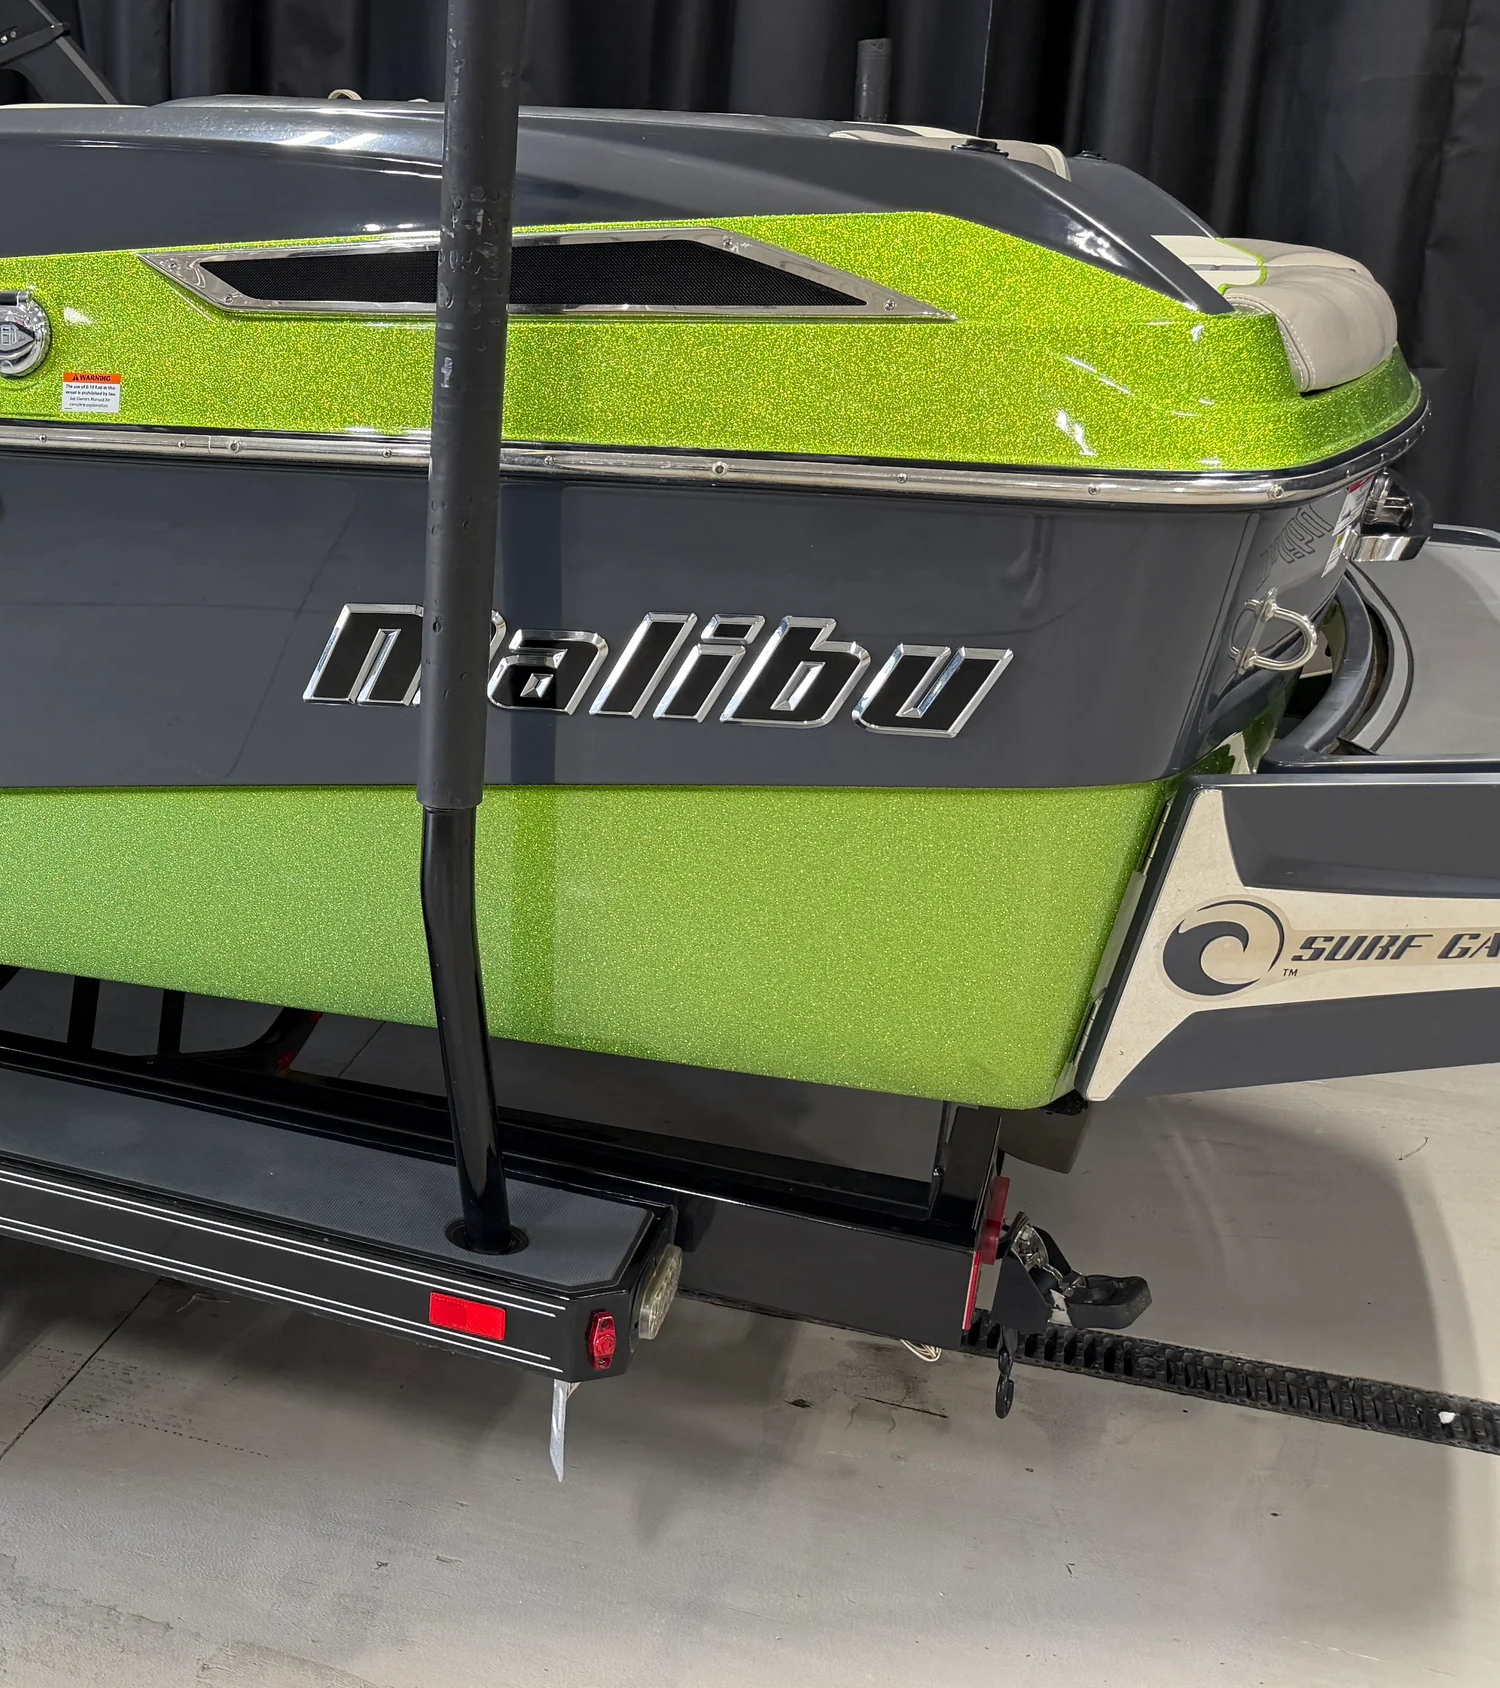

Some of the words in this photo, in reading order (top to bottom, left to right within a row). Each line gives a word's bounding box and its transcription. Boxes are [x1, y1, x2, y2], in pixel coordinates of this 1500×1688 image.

[80, 374, 111, 382] WARNING
[1291, 934, 1434, 962] SURF
[1282, 968, 1298, 977] TM
